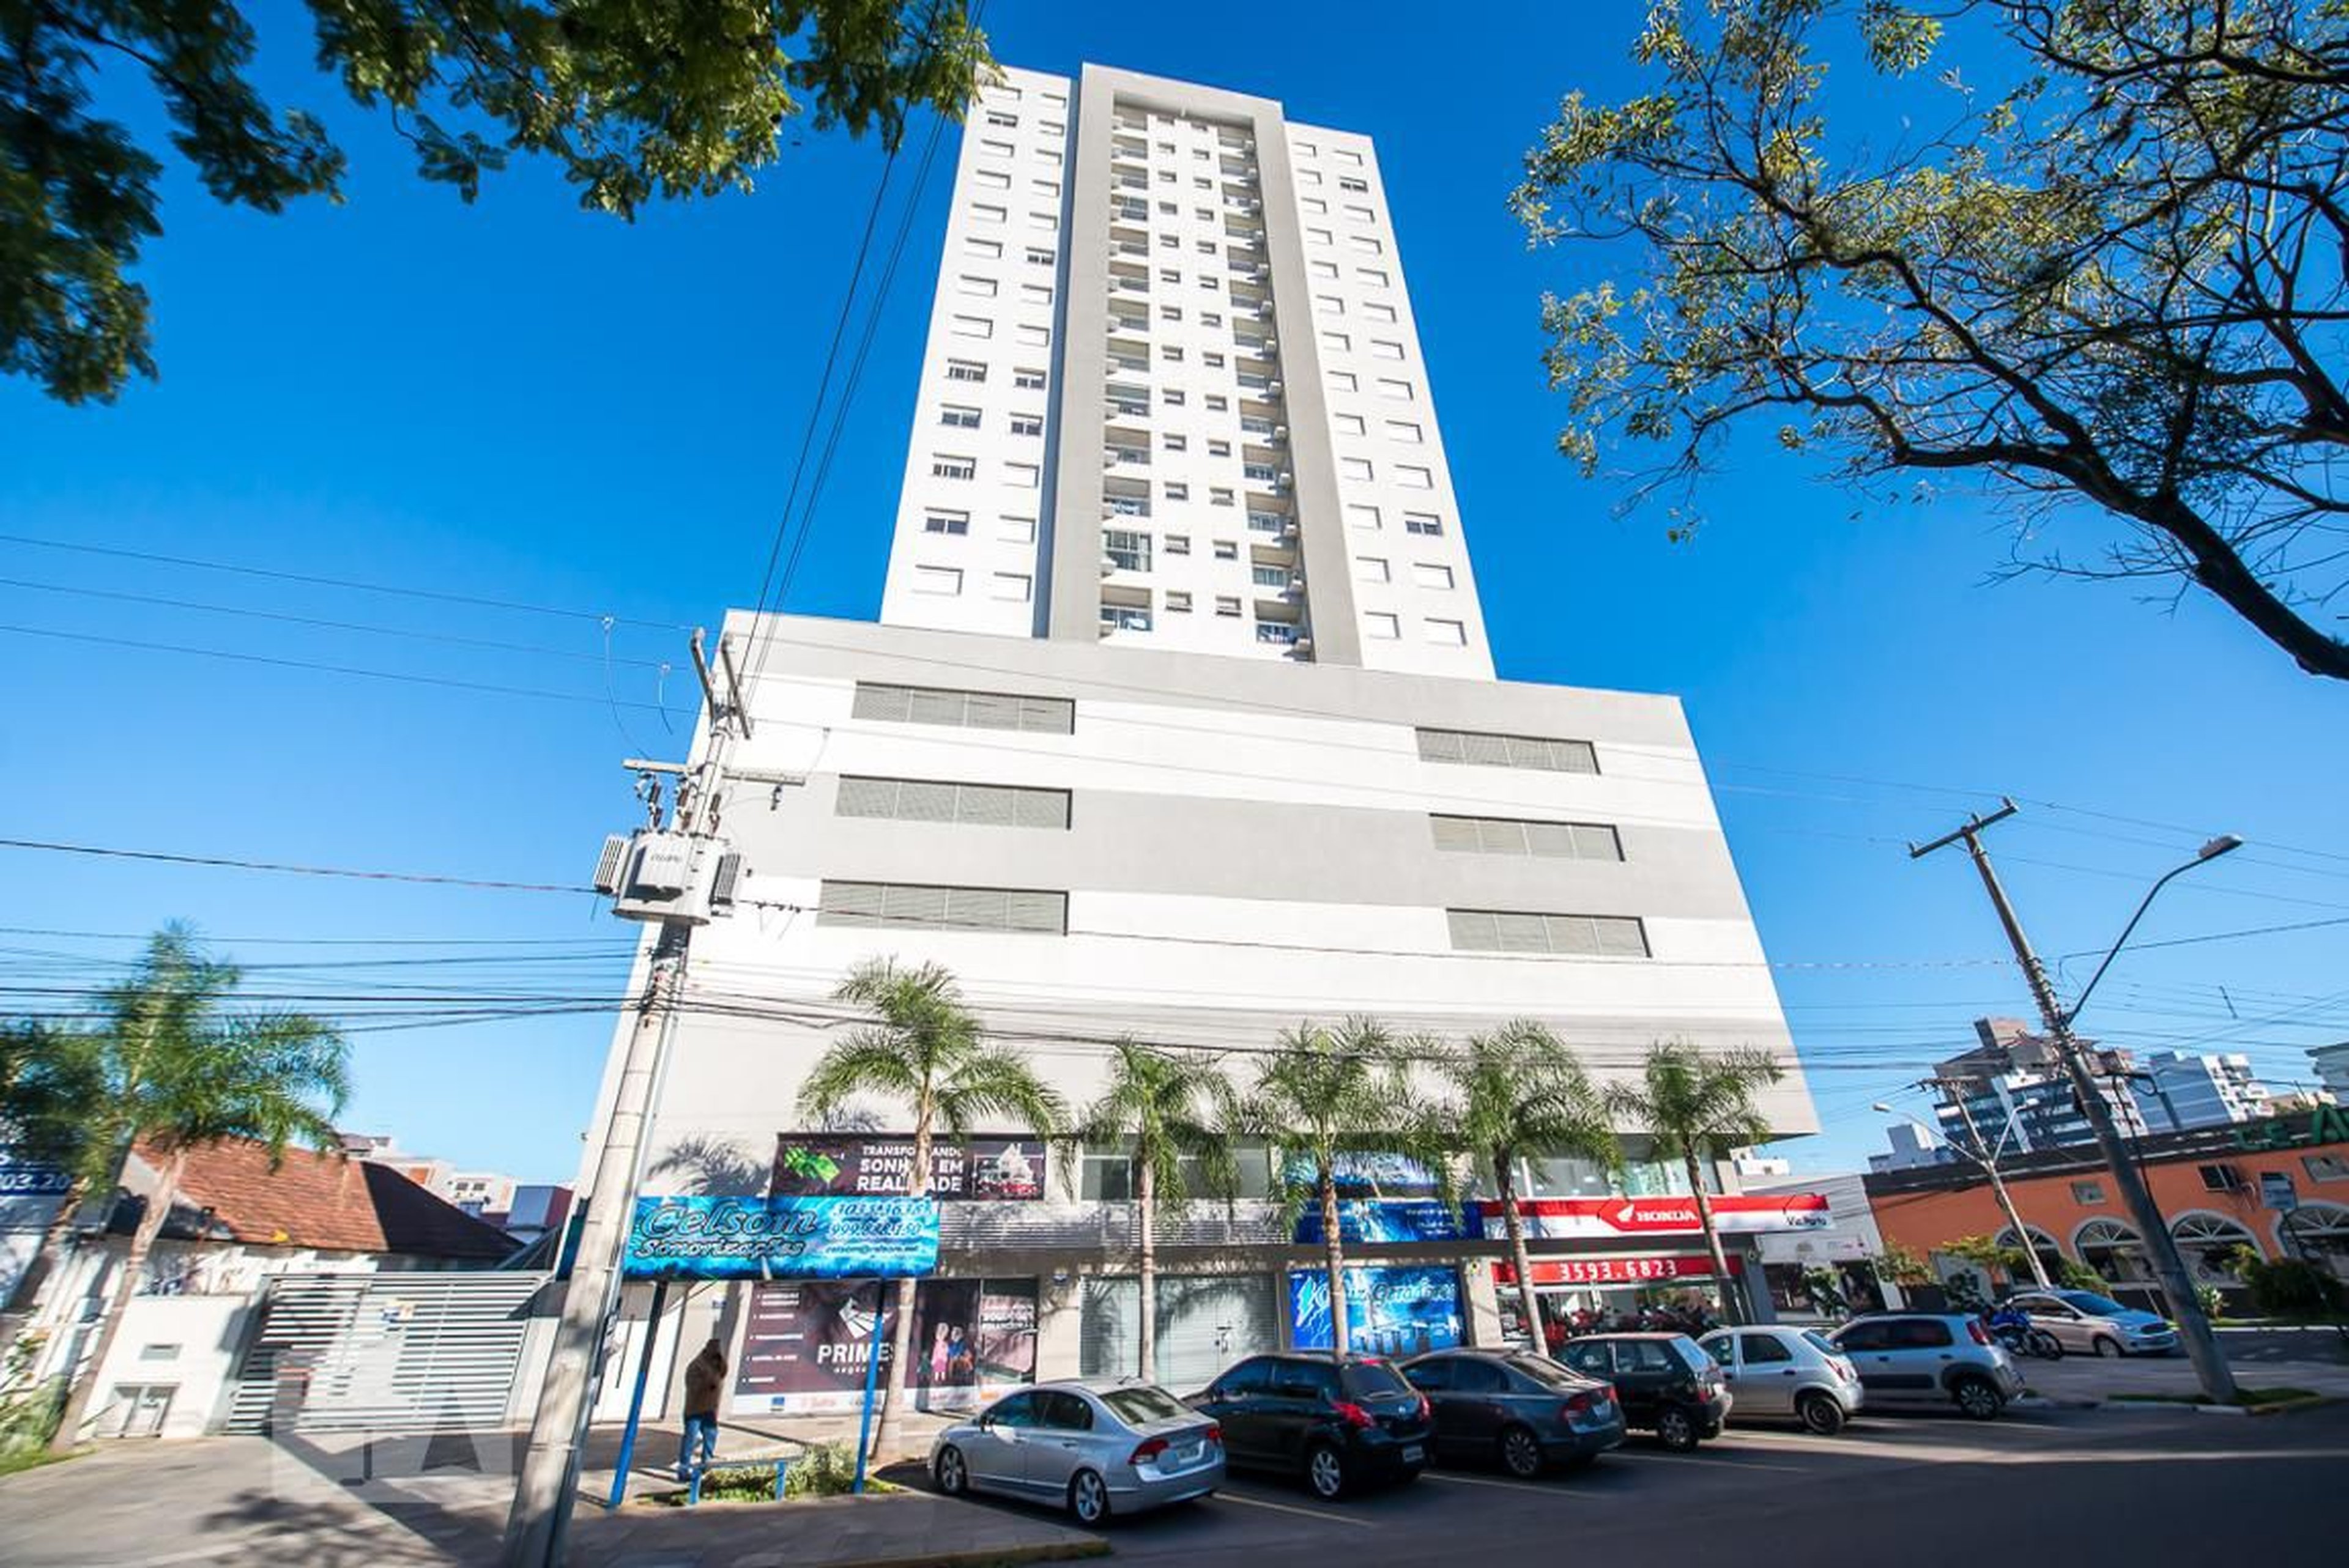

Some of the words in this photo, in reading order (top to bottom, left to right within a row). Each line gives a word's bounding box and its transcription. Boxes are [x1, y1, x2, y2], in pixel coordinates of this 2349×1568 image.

[863, 1145, 965, 1158] TRANSFOANDO
[859, 1158, 934, 1173] SONH
[938, 1158, 964, 1174] EM
[857, 1175, 963, 1192] REALADE
[641, 1200, 818, 1238] Celsom
[1636, 1210, 1699, 1222] HONDA
[634, 1237, 806, 1262] Sonorizações
[1559, 1260, 1677, 1281] 3593.6823
